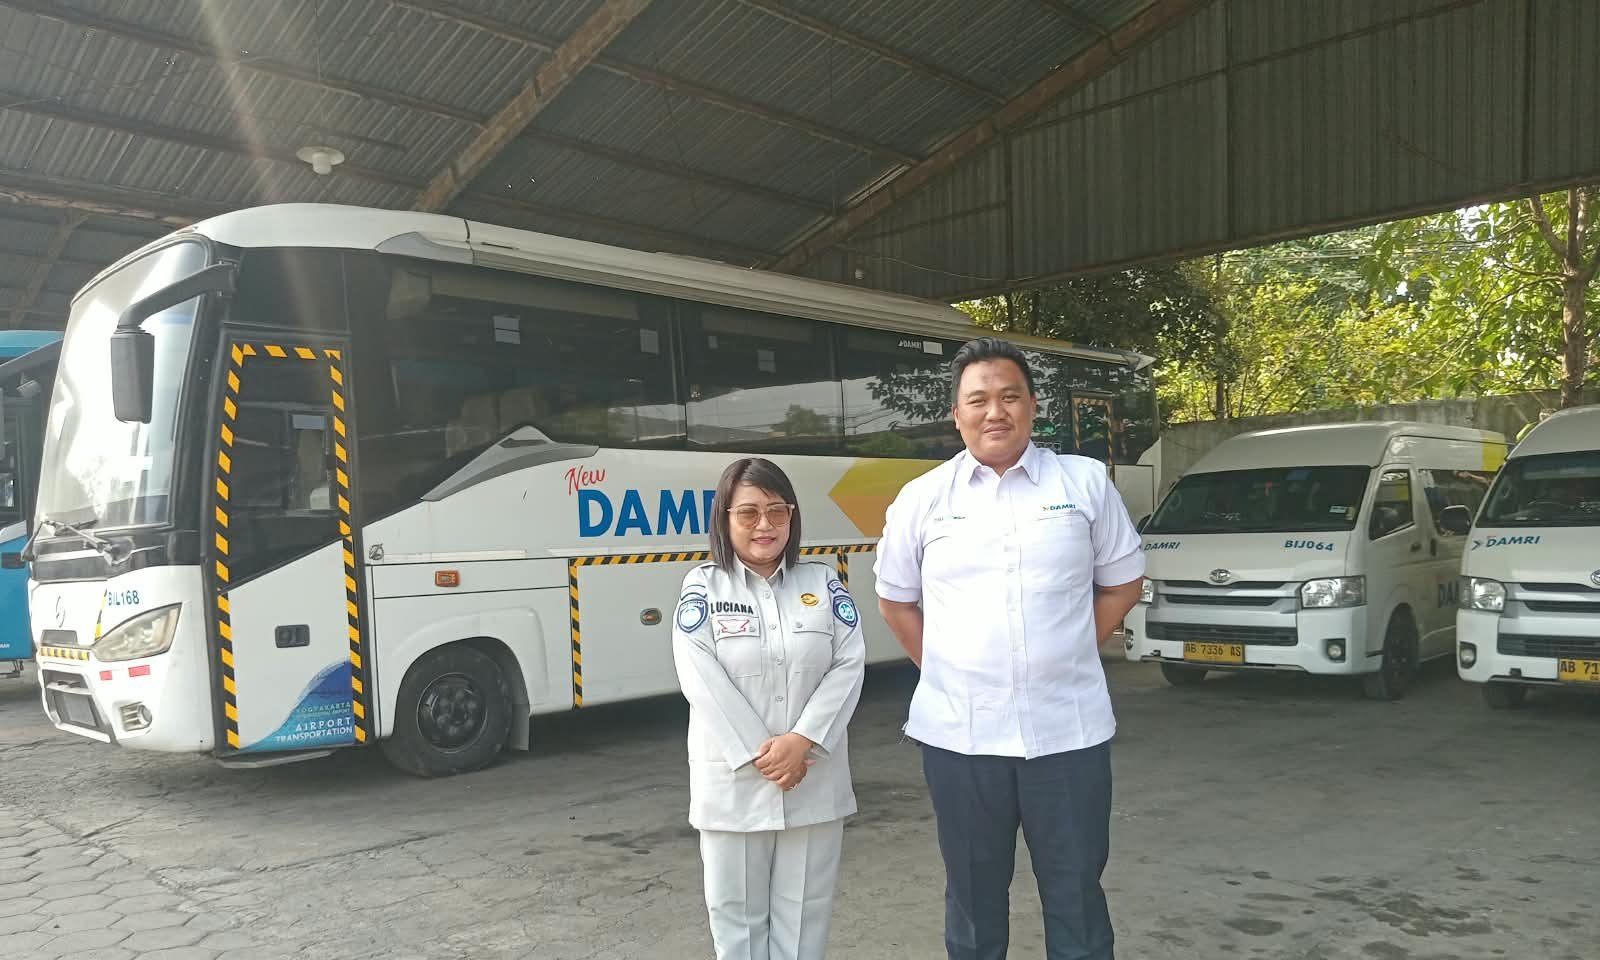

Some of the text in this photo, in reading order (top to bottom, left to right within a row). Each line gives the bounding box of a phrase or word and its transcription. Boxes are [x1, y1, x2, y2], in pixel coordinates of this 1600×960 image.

[565, 465, 606, 496] New
[1050, 503, 1076, 511] DAMRI
[1144, 541, 1181, 551] DAMRI
[1284, 540, 1335, 551] BIJ064
[1486, 536, 1541, 548] DAMRI
[108, 590, 140, 606] BIL168
[711, 601, 754, 615] LUCIANA
[1230, 646, 1241, 657] AS
[1560, 660, 1576, 673] AB
[295, 717, 351, 732] AIRPORT
[276, 725, 353, 742] TRANSPORTATION
